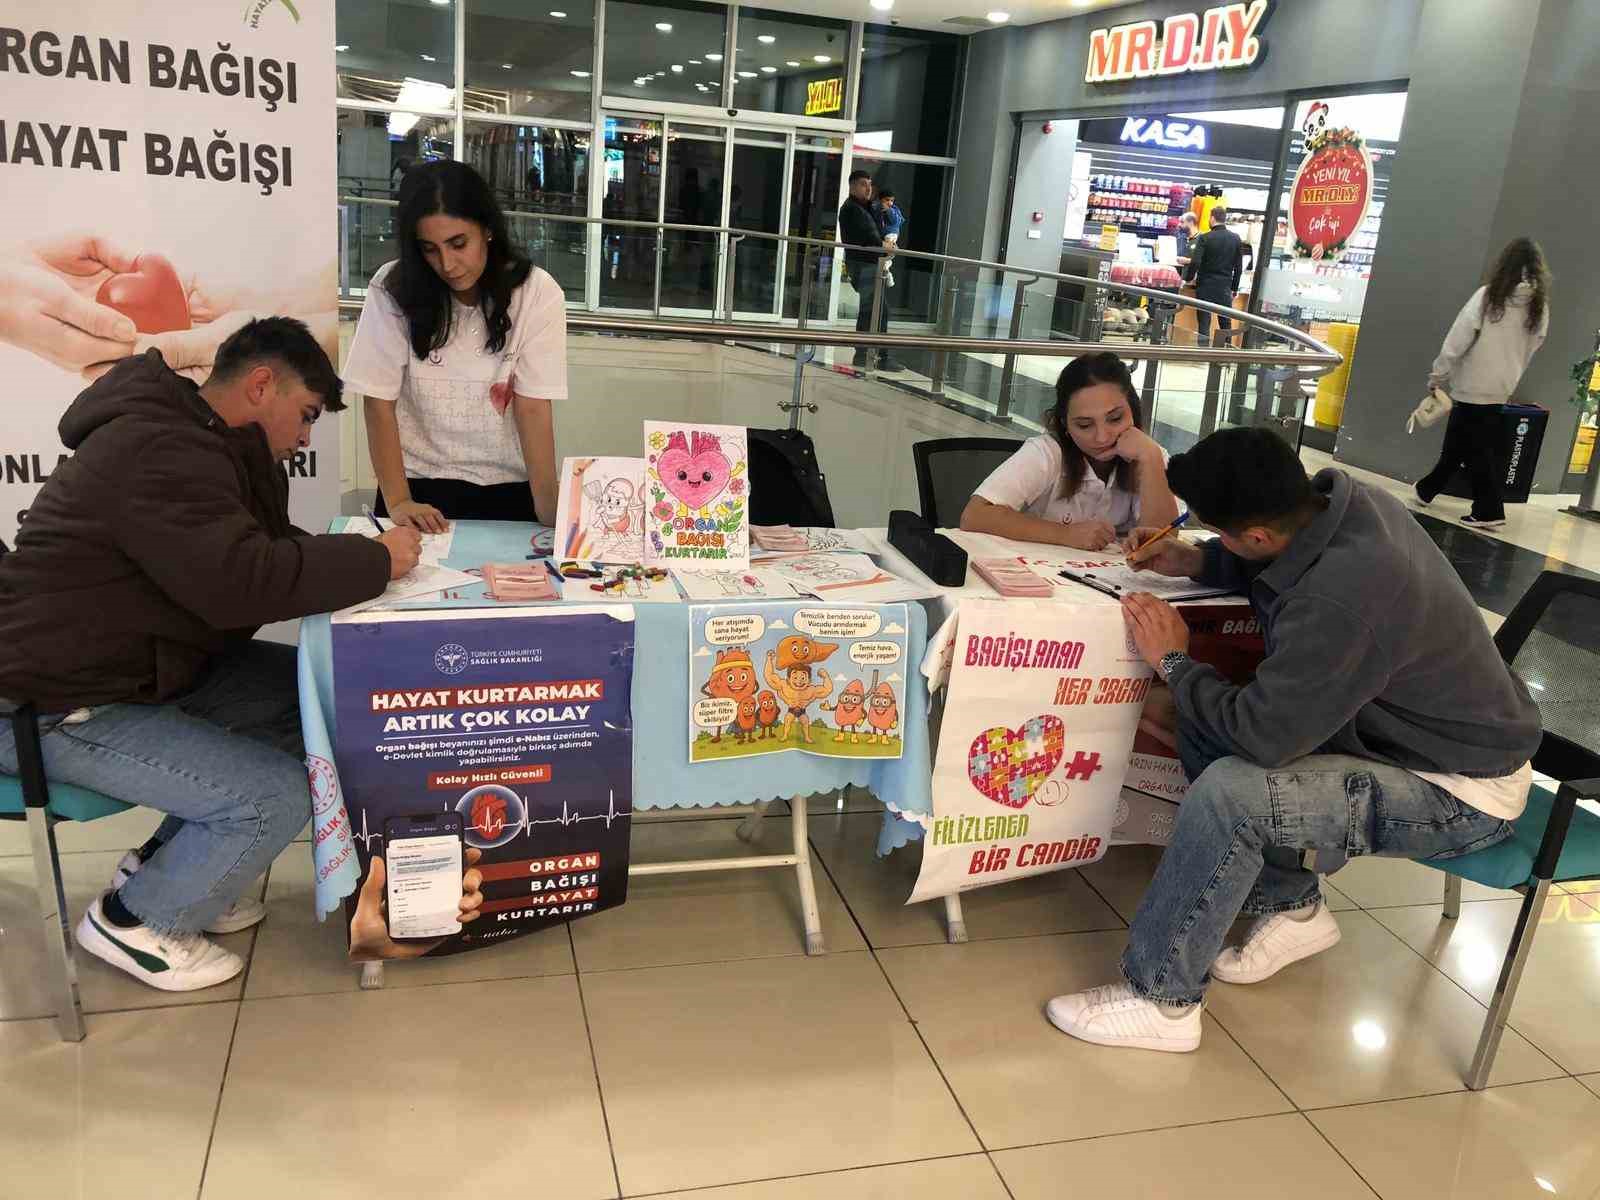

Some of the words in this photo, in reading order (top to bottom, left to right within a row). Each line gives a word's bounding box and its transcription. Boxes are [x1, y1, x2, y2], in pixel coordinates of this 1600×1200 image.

[147, 41, 297, 112] BAĞIŞI
[1120, 117, 1206, 150] KASA
[144, 128, 292, 196] BAĞIŞI
[470, 657, 498, 665] SAĞLIK
[500, 655, 542, 664] BAKANLIĞI
[372, 690, 450, 711] HAYAT
[457, 683, 601, 705] KURTARMAK
[1053, 677, 1093, 706] HER
[1093, 677, 1150, 705] ORGAN
[383, 713, 455, 733] ARTIK
[460, 710, 510, 732] ÇOK
[515, 705, 590, 724] KOLAY
[375, 744, 406, 753] Organ
[408, 741, 438, 751] bağışı
[440, 739, 487, 749] beyanınızı
[489, 735, 514, 746] şimdi
[516, 734, 551, 743] e-Nabız
[384, 751, 423, 761] e-Devlet
[425, 749, 455, 758] kimlik
[457, 744, 527, 757] doğrulamasıyla
[529, 743, 557, 752] birkaç
[559, 739, 592, 748] adımda
[459, 754, 521, 766] yapabilirsiniz.
[436, 775, 468, 785] Kolay
[472, 773, 497, 782] Hızlı
[529, 855, 597, 873] ORGAN
[968, 845, 1011, 875] BİR
[531, 873, 597, 892] BAĞIŞI
[532, 888, 595, 904] HAYAT
[497, 902, 593, 921] KURTARIR
